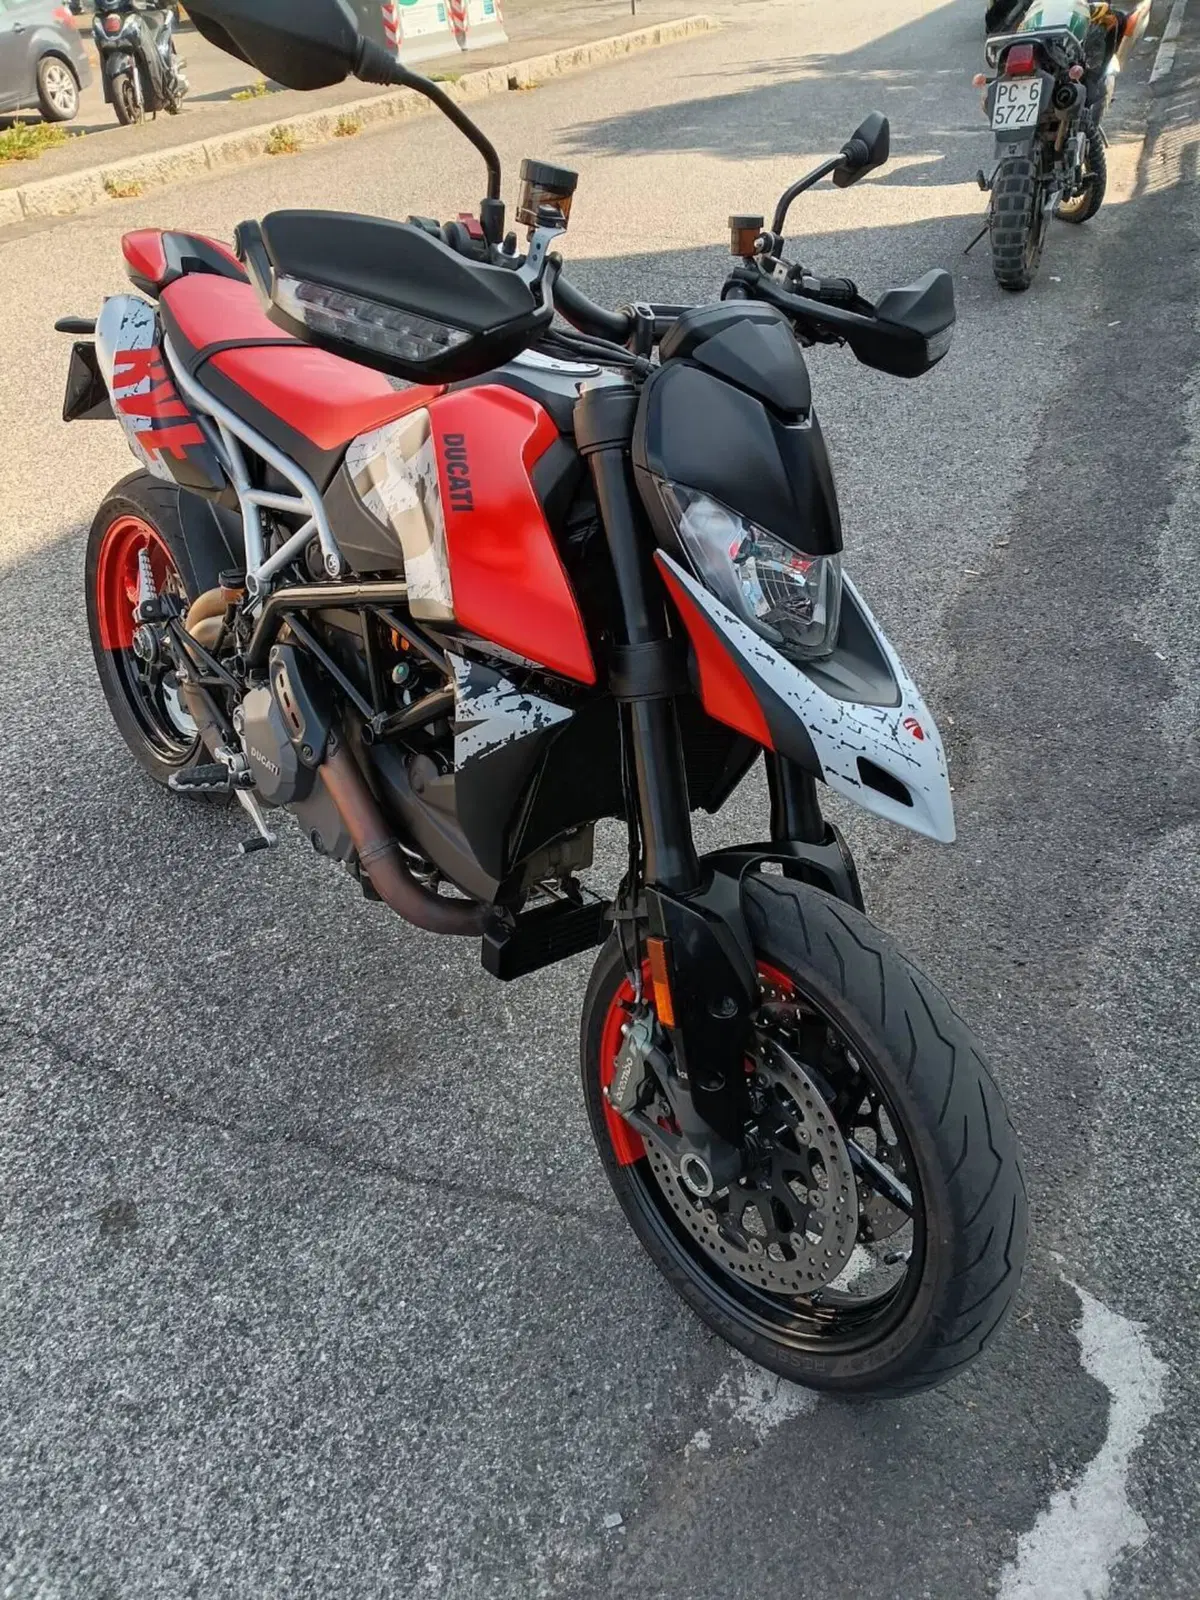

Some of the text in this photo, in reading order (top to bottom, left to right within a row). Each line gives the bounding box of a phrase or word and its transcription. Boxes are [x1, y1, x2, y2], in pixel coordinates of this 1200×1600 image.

[997, 82, 1039, 103] PC 6
[995, 103, 1037, 124] 5727
[442, 433, 475, 512] DUCATI
[250, 746, 280, 776] DUCATI
[615, 1057, 633, 1101] brembo
